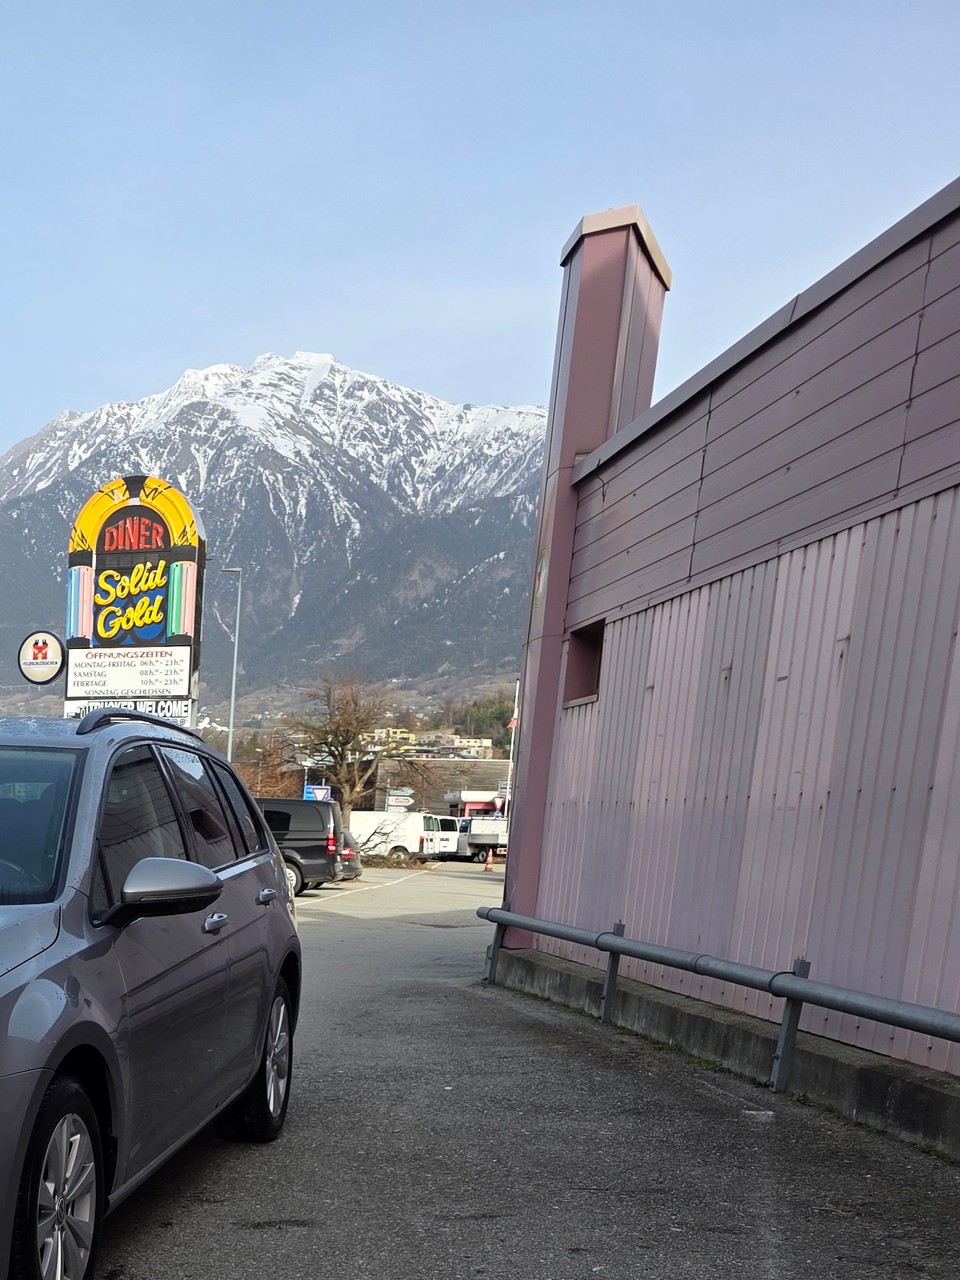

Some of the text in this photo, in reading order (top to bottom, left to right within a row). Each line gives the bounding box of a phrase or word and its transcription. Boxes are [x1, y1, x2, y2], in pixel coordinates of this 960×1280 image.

[104, 516, 165, 552] DINER
[94, 560, 168, 606] Solid
[97, 595, 164, 639] Gold
[85, 650, 173, 660] ÖFFNUNGSZEITEN
[73, 660, 137, 669] MONTAG-FREITAG
[73, 670, 107, 678] SAMSTAG
[73, 680, 108, 688] FEIERTAGE
[121, 688, 172, 696] GESCHLOSSEN
[136, 700, 189, 718] WELCOME
